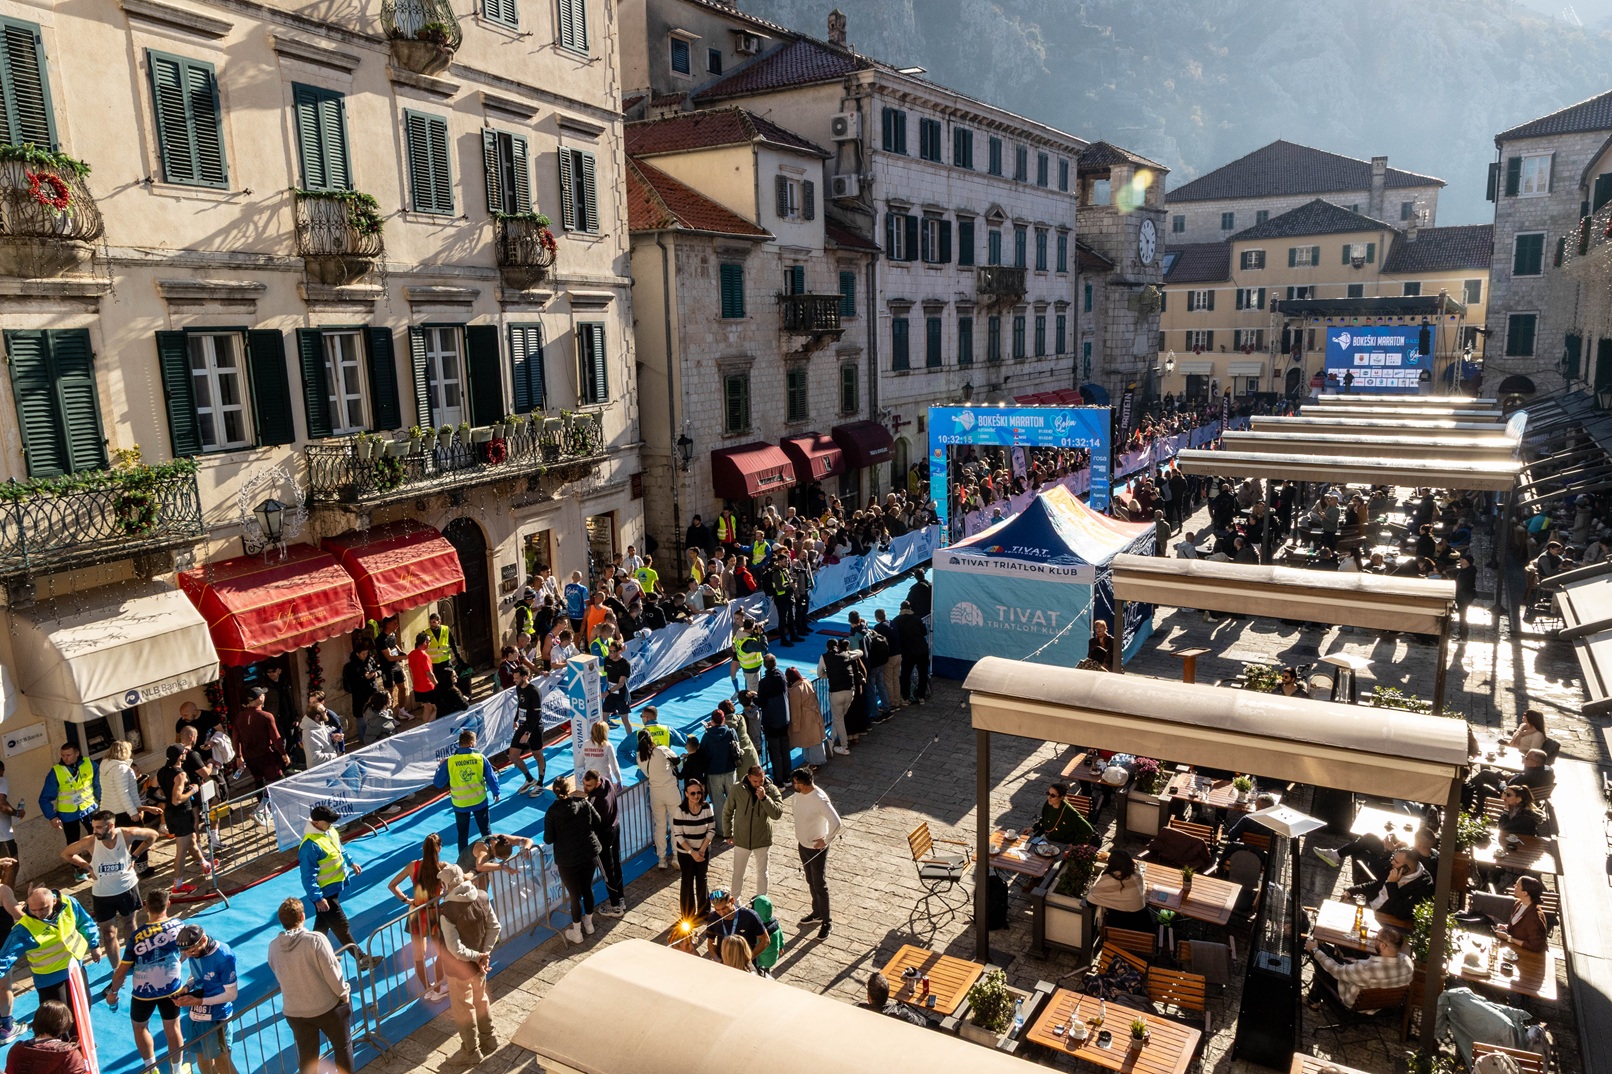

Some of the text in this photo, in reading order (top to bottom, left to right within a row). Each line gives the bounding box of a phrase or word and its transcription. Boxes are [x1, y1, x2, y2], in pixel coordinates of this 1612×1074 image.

[1353, 335, 1376, 346] BOKEŠKI
[1377, 336, 1404, 346] MARATON
[978, 414, 1045, 428] BOKEŠKI MARATON
[938, 435, 973, 444] 10:32:15
[1061, 438, 1101, 447] 01:32:14
[1012, 545, 1050, 555] TIVAT
[961, 558, 1078, 576] TIVAT TRIATLON KLUB
[995, 605, 1061, 627] TIVAT
[987, 620, 1070, 636] TRIATLON KLUB
[141, 678, 188, 699] NLB Banka
[571, 697, 586, 710] PB
[455, 758, 478, 767] VOLONTER
[134, 923, 163, 944] RUN
